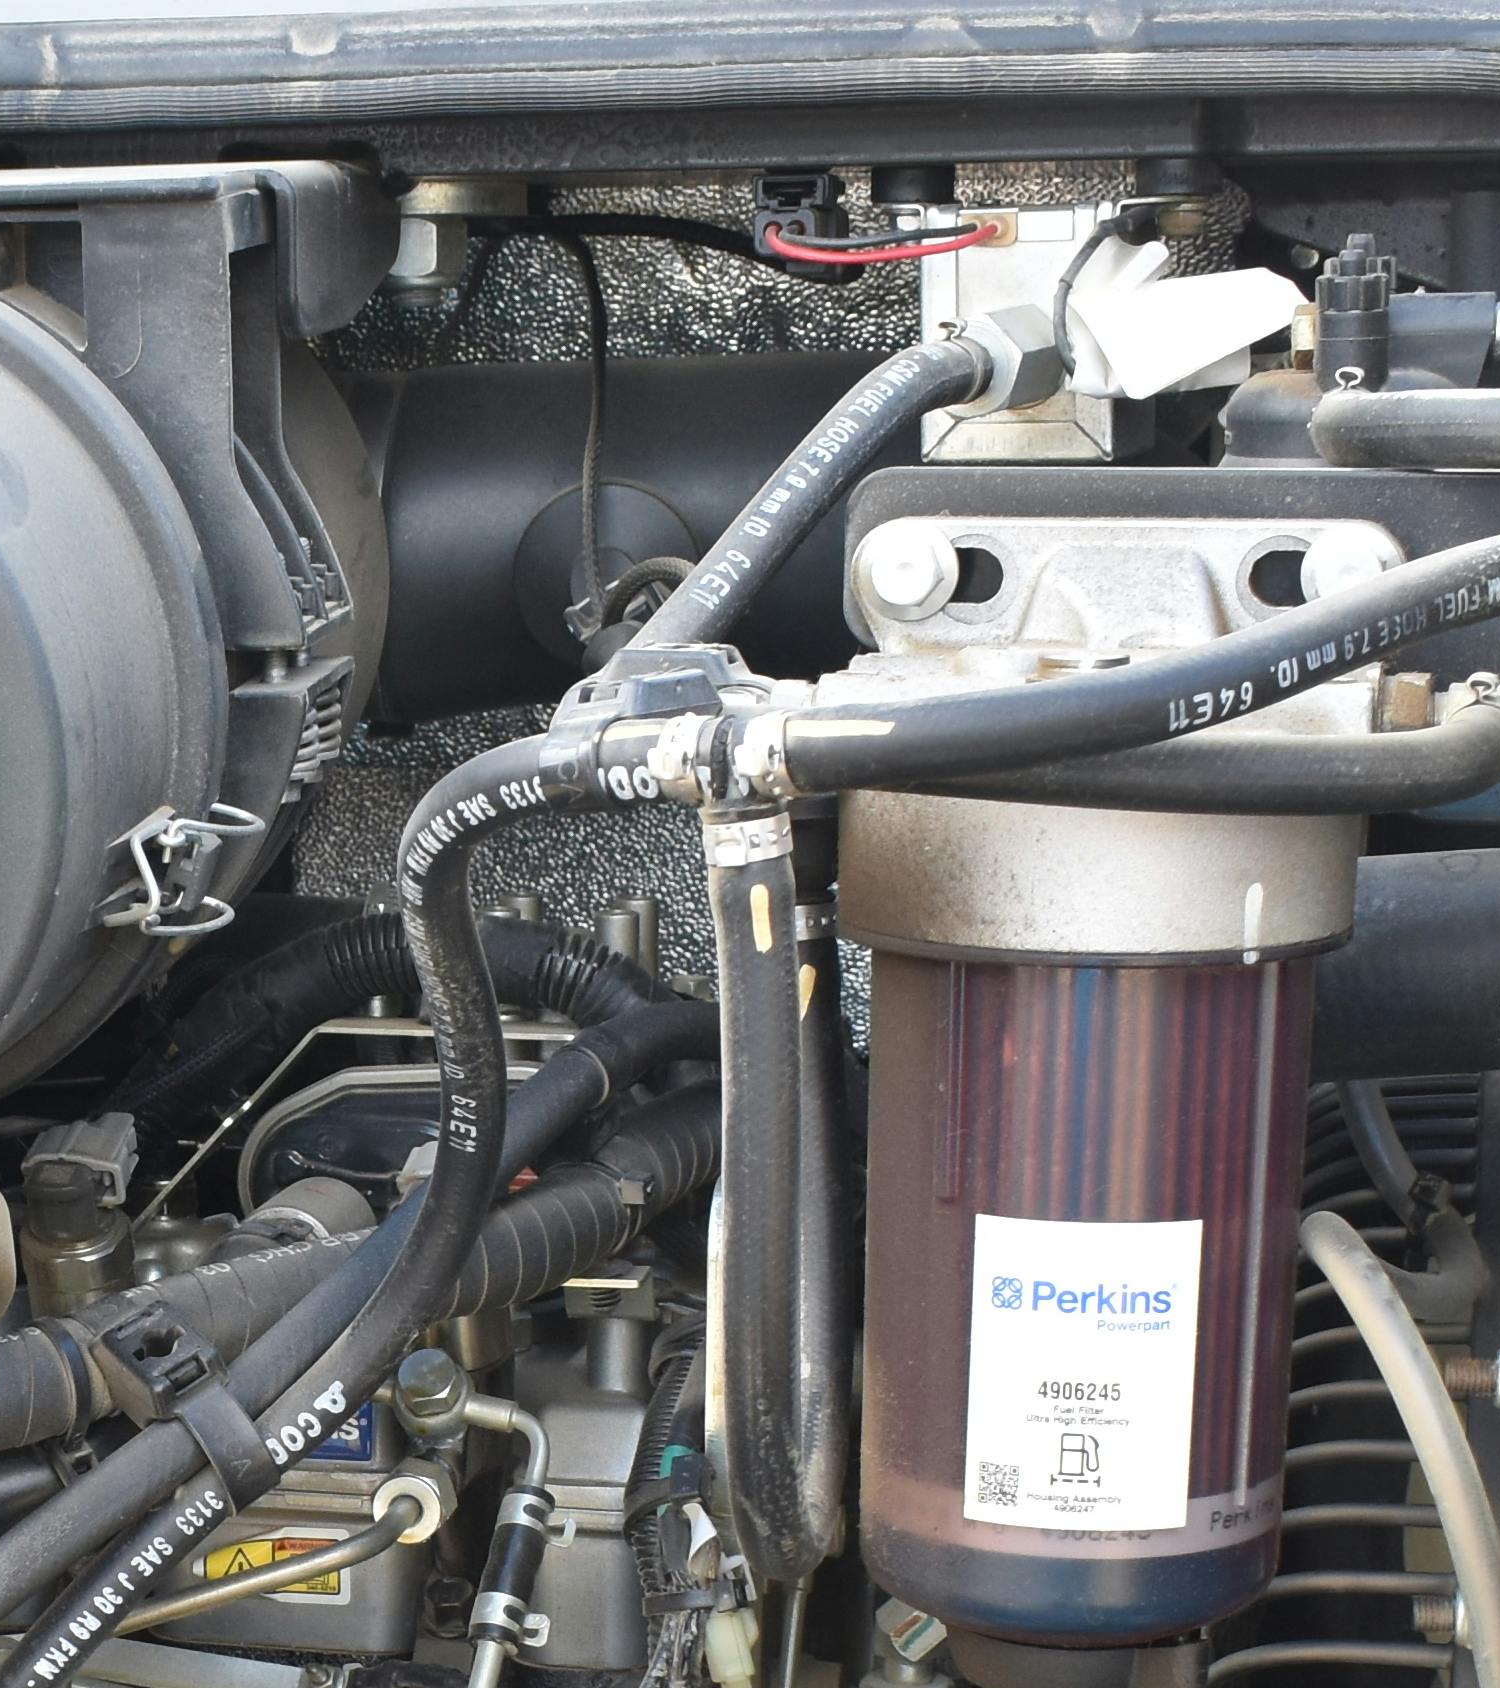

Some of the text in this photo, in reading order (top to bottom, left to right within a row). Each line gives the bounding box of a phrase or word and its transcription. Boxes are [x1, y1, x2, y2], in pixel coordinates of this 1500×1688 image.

[881, 359, 921, 387] CSM
[848, 383, 894, 417] FUEL
[808, 416, 860, 463] HOSE
[785, 461, 820, 489] 7.9
[759, 487, 792, 514] mm
[1434, 584, 1480, 622] FUEL
[1377, 600, 1428, 647] HOSE
[1306, 641, 1337, 671] mm
[1344, 626, 1374, 661] 7.9
[457, 792, 497, 826] SAE
[1031, 1281, 1172, 1314] Perkins
[1097, 1319, 1171, 1333] Powerpart
[1037, 1381, 1121, 1401] 4906245
[1053, 1405, 1104, 1415] Fuel Filter
[1053, 1416, 1076, 1426] High
[1080, 1416, 1130, 1427] Efficiency
[175, 1490, 224, 1535] 3133
[1026, 1491, 1122, 1505] Housing Assembly
[130, 1537, 174, 1577] SAE
[117, 1572, 135, 1591] J
[93, 1586, 124, 1615] 30
[68, 1610, 102, 1640] R9
[33, 1636, 79, 1680] FKM
